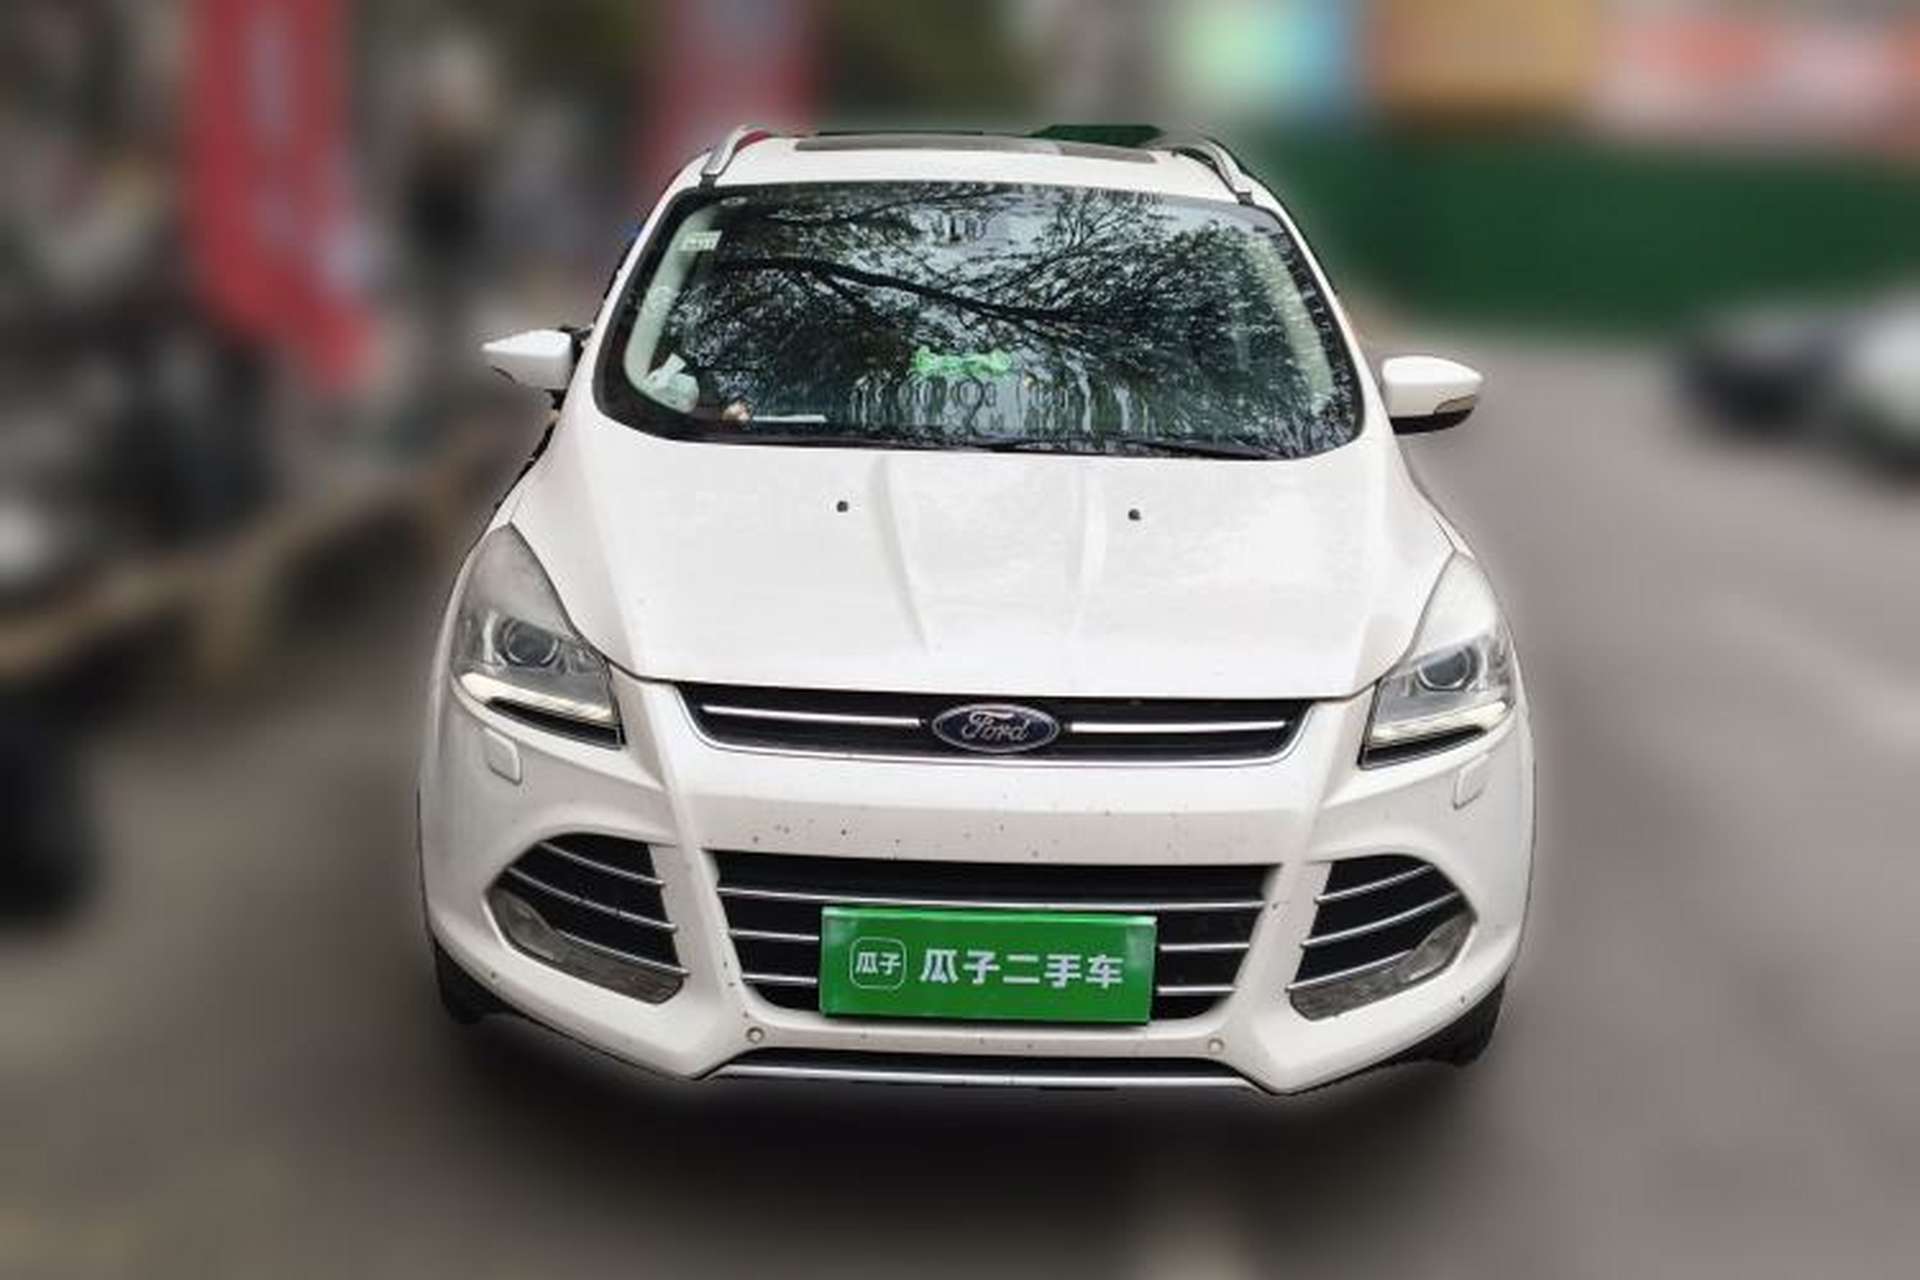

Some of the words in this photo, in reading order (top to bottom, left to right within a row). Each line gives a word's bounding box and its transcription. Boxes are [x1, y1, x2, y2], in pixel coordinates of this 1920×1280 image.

[962, 711, 1031, 741] Ford
[855, 951, 902, 976] 瓜子
[919, 949, 1124, 989] 瓜子二手车
